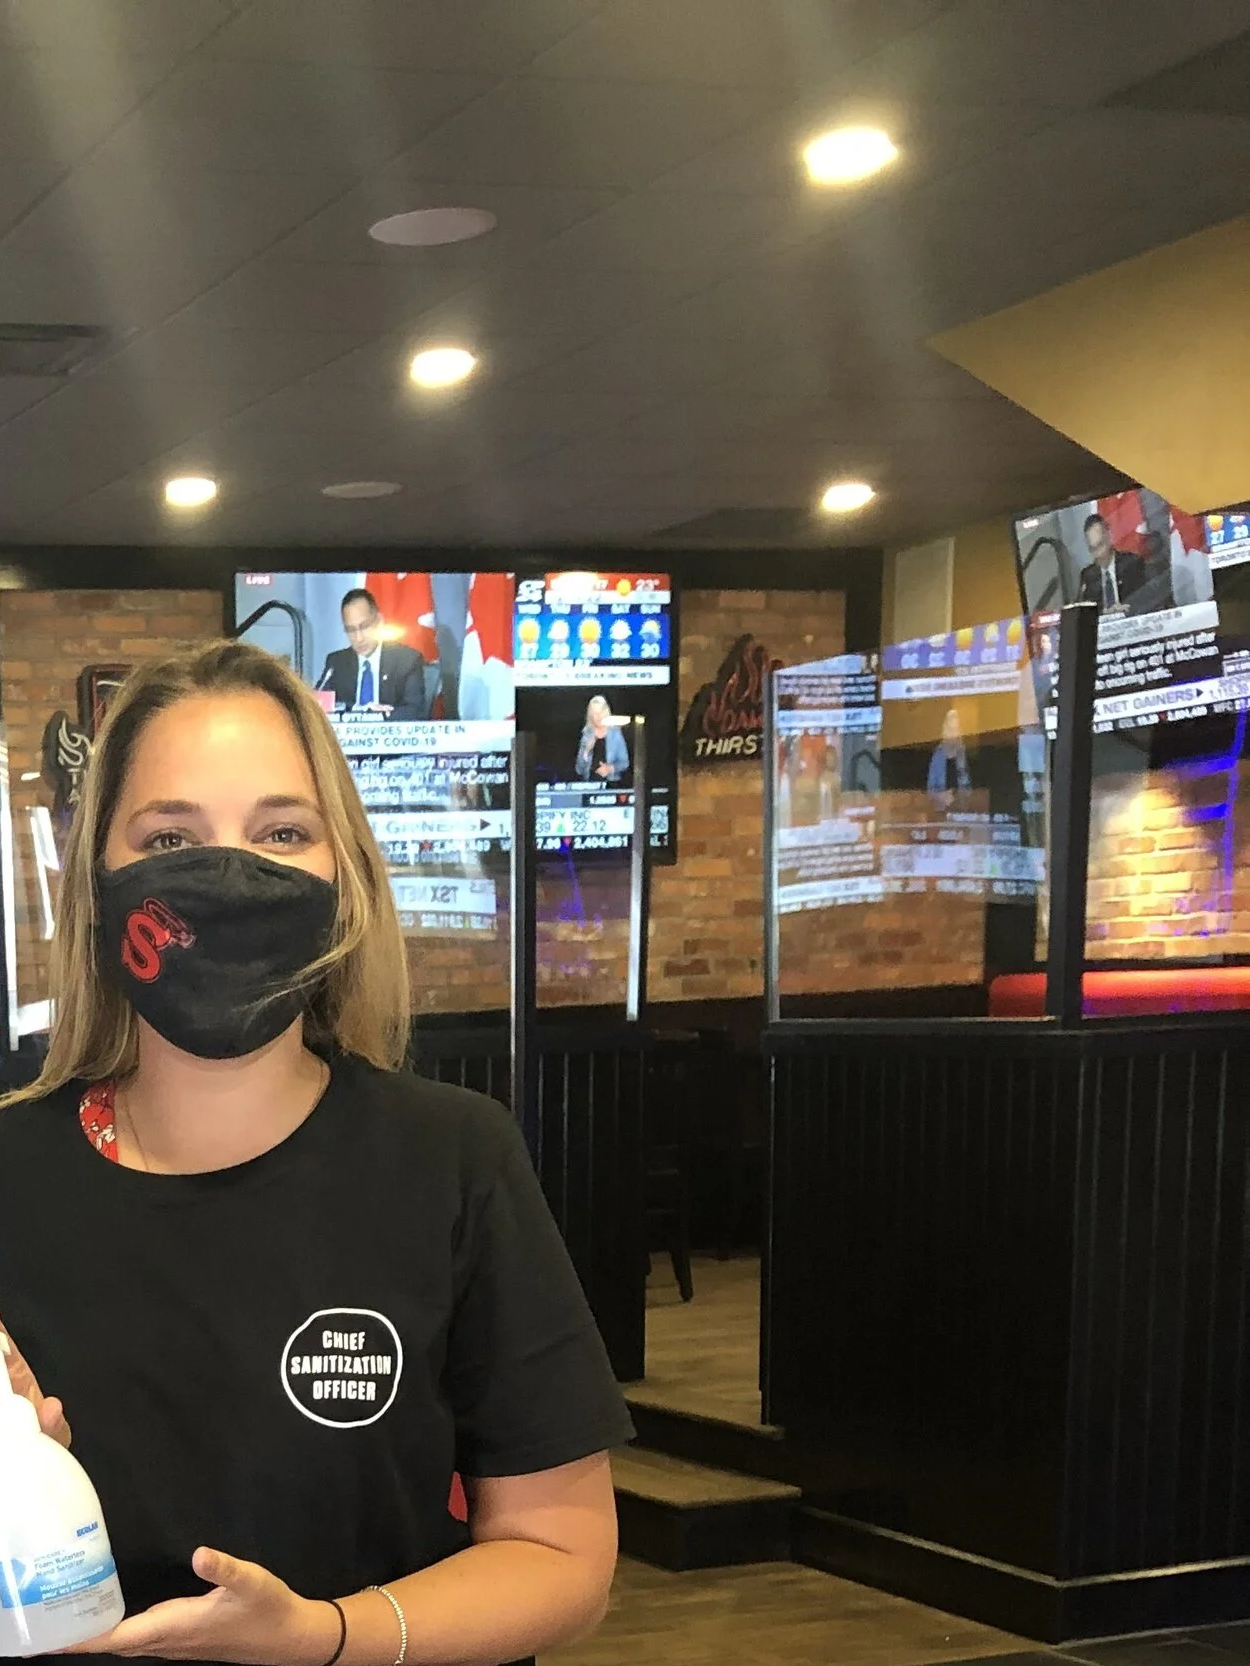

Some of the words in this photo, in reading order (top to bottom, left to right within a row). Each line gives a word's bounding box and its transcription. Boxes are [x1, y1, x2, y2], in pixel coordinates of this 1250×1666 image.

[346, 725, 403, 735] PROVIDES
[407, 724, 451, 735] UPDATE
[695, 734, 760, 757] THIRS
[322, 1330, 366, 1351] CHIEF
[290, 1355, 392, 1375] SANITIZATION
[312, 1380, 376, 1401] OFFICER
